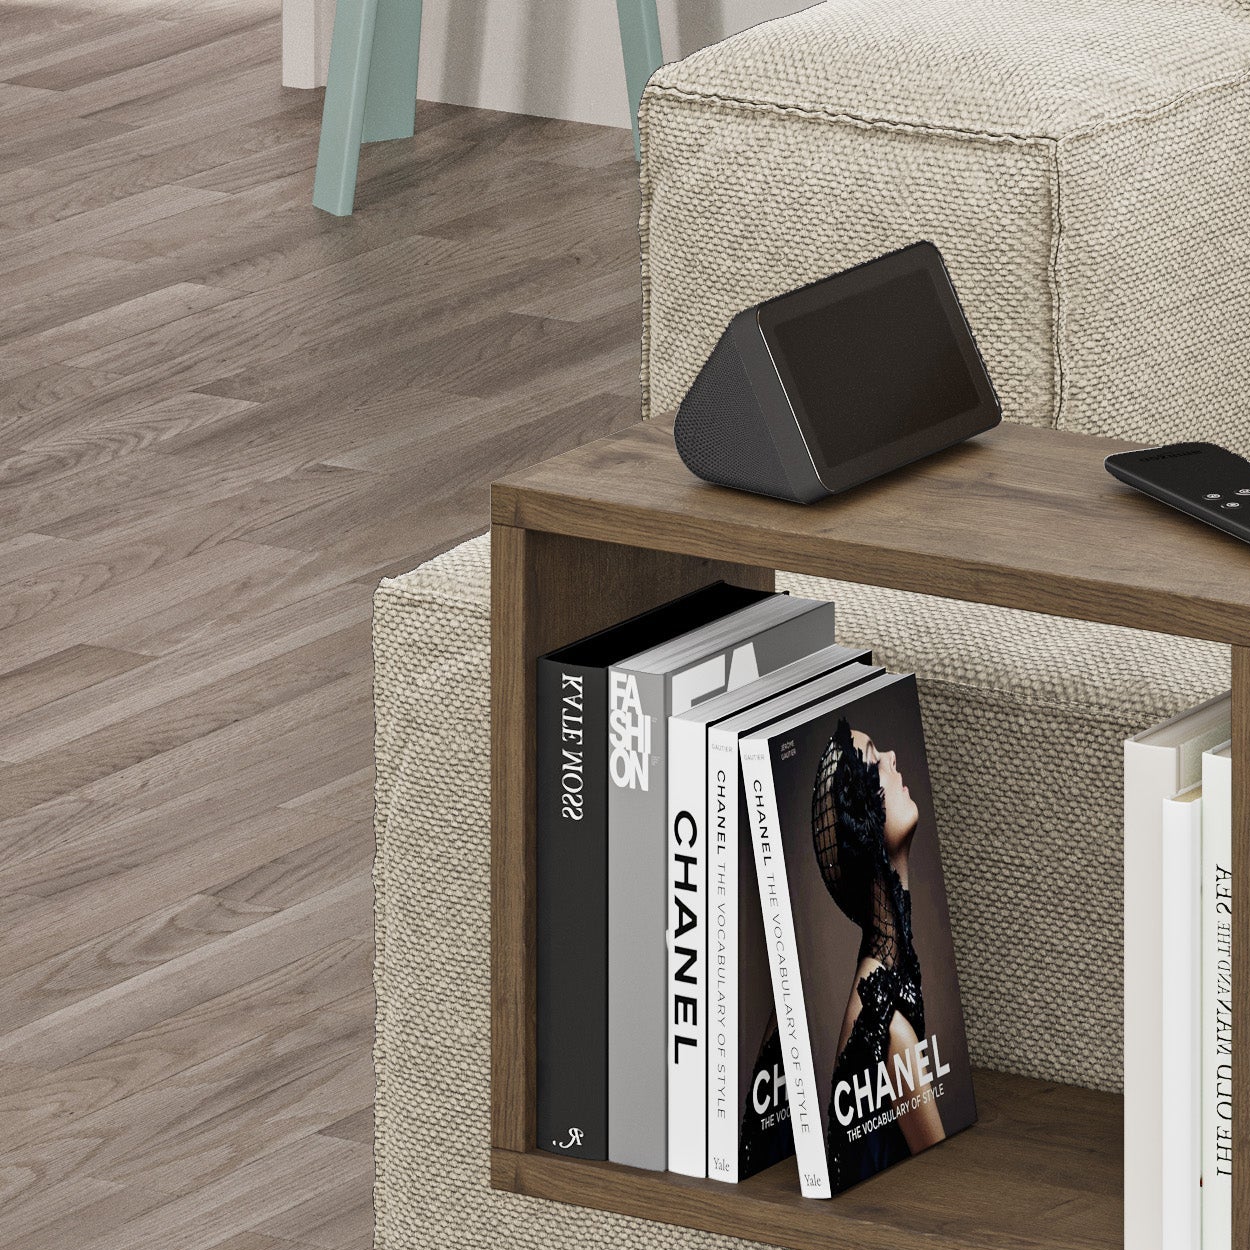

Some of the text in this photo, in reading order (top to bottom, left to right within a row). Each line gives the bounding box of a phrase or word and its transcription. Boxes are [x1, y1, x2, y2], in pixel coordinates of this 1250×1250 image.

[674, 810, 698, 1065] CHANEL
[717, 770, 726, 1120] CHANEL THE VOCABULARY OF STYLE
[753, 779, 810, 1134] CHANEL THE VOCABULARY OF STYLE
[752, 1063, 790, 1115] CH
[834, 1034, 951, 1127] CHANEL
[760, 1115, 775, 1131] THE
[847, 1083, 945, 1142] THE VOCABULARY OF STYLE
[713, 1157, 730, 1172] Yale
[804, 1173, 822, 1188] Yale
